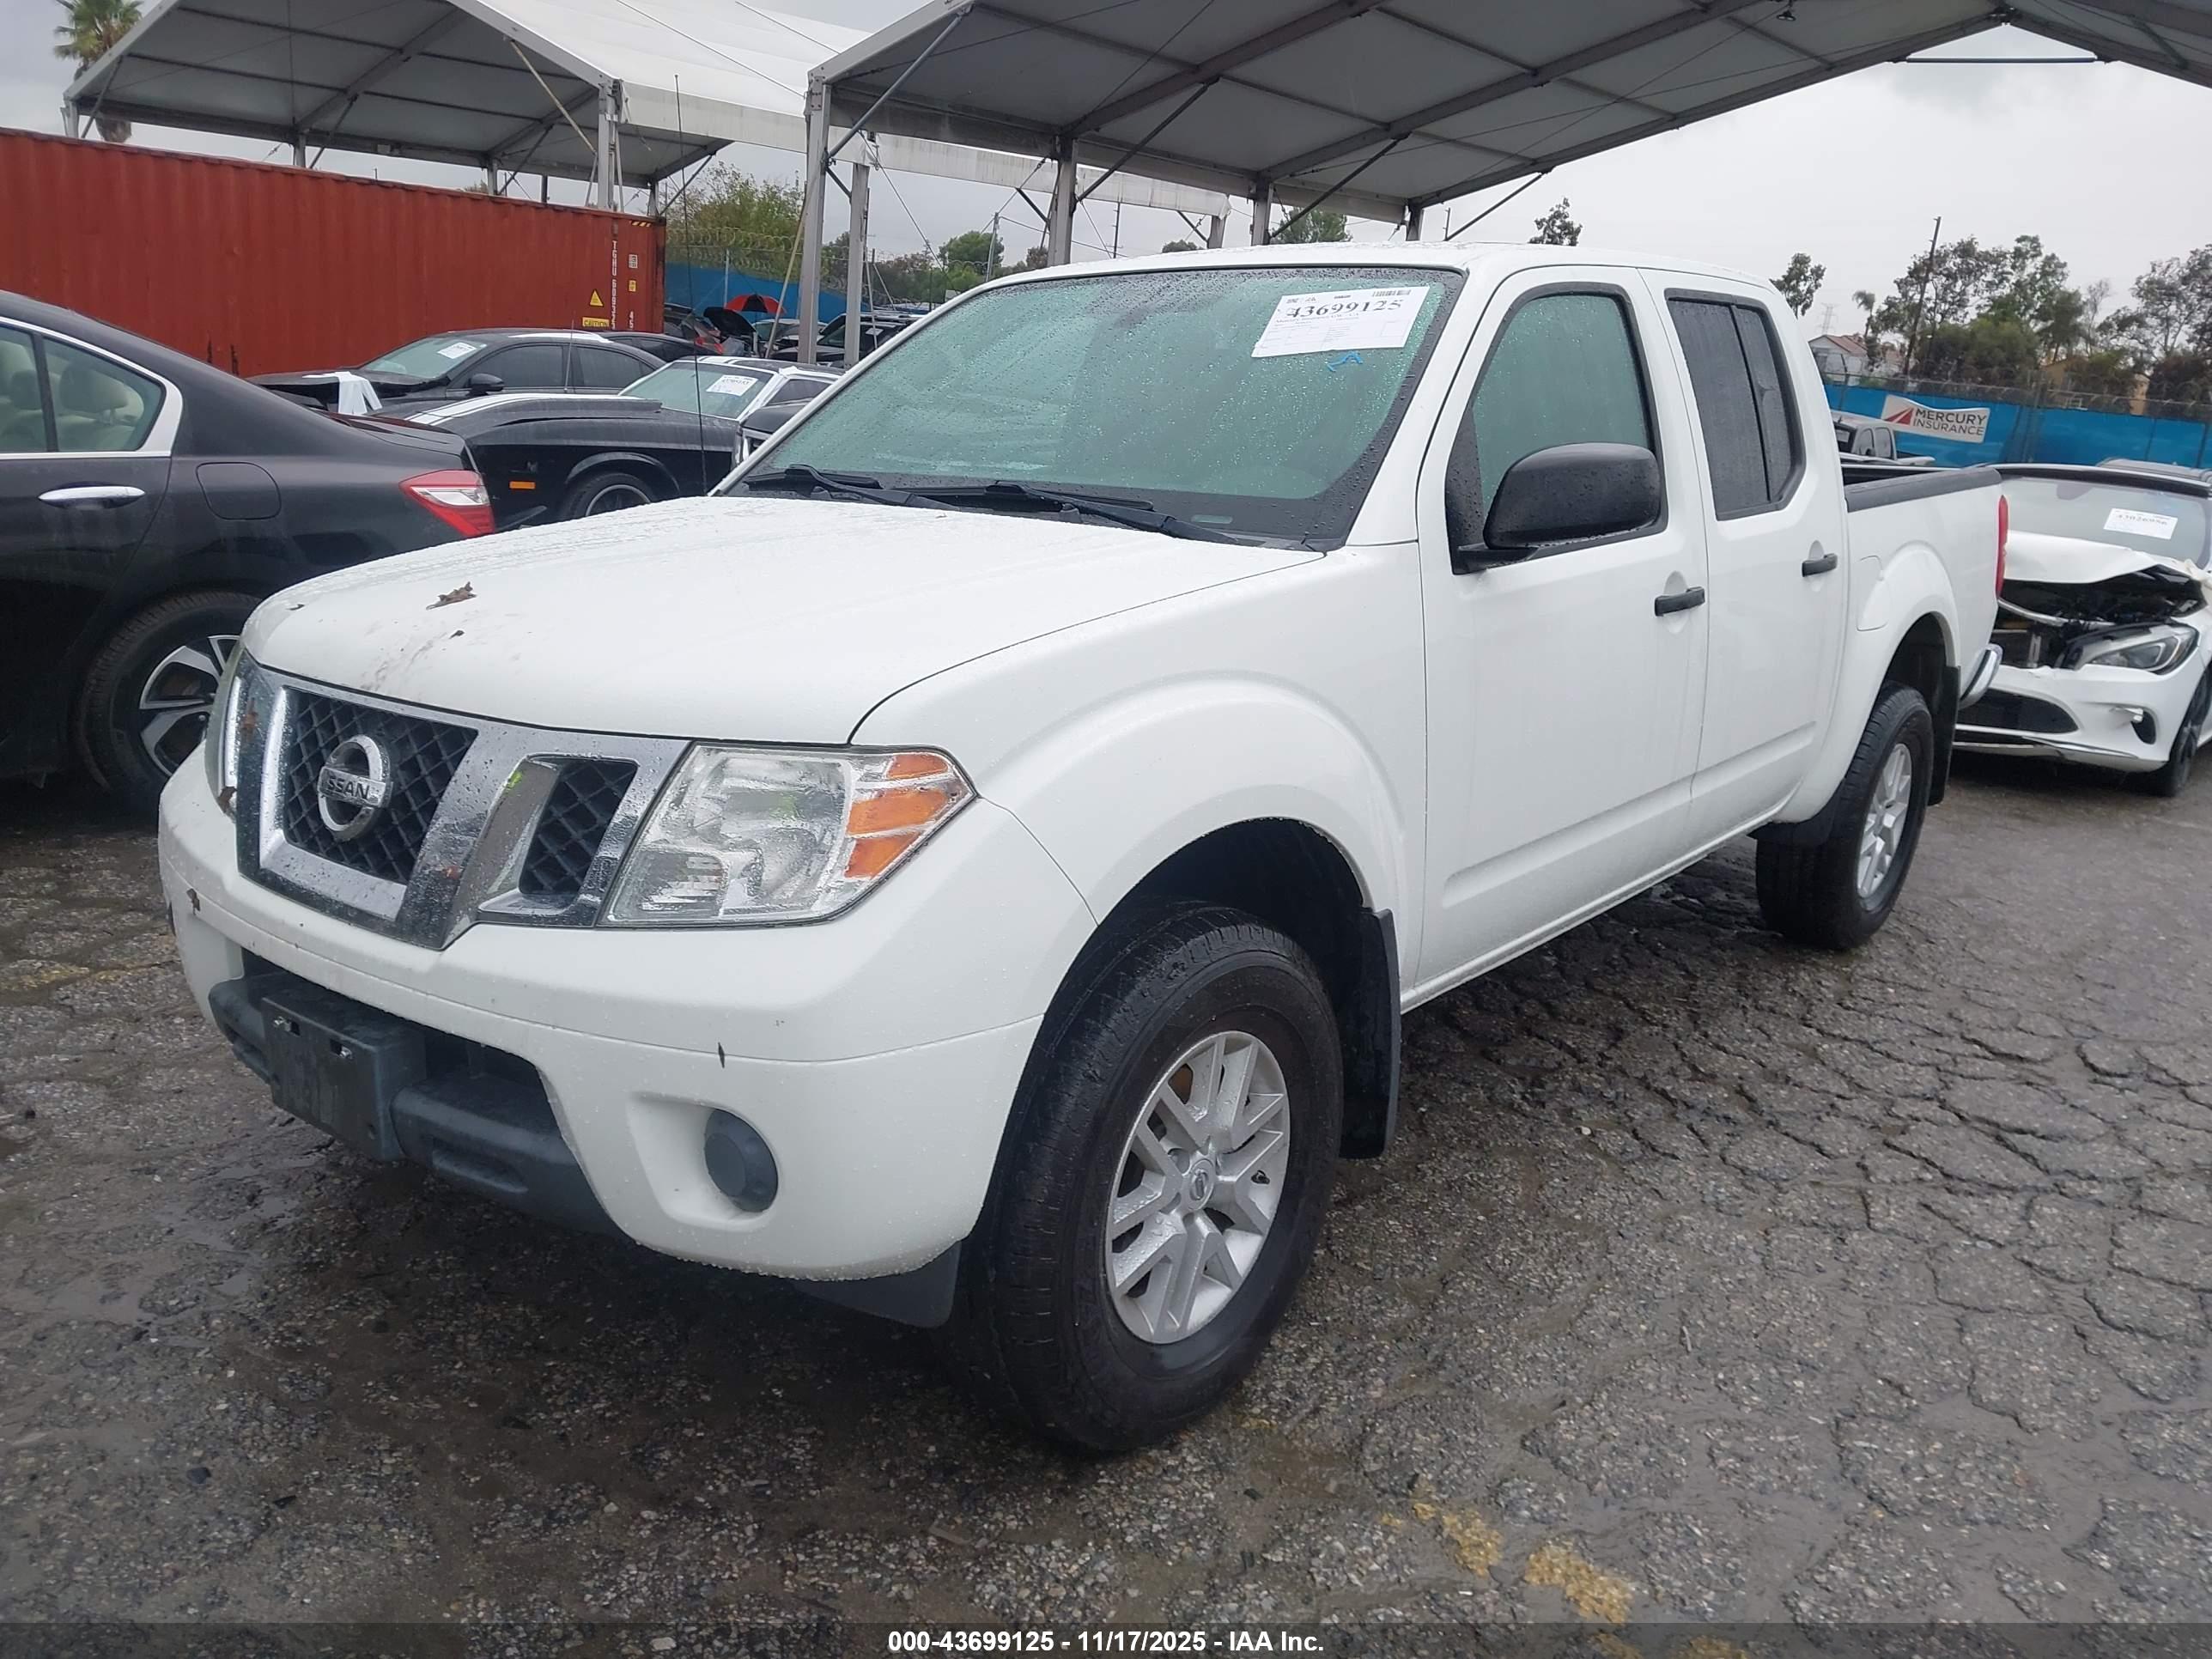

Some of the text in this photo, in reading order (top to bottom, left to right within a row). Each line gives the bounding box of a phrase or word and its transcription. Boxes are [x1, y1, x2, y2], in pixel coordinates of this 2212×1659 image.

[1287, 300, 1402, 318] 43699125
[1916, 408, 1987, 425] MERCURY
[1913, 418, 1984, 436] INSURANCE
